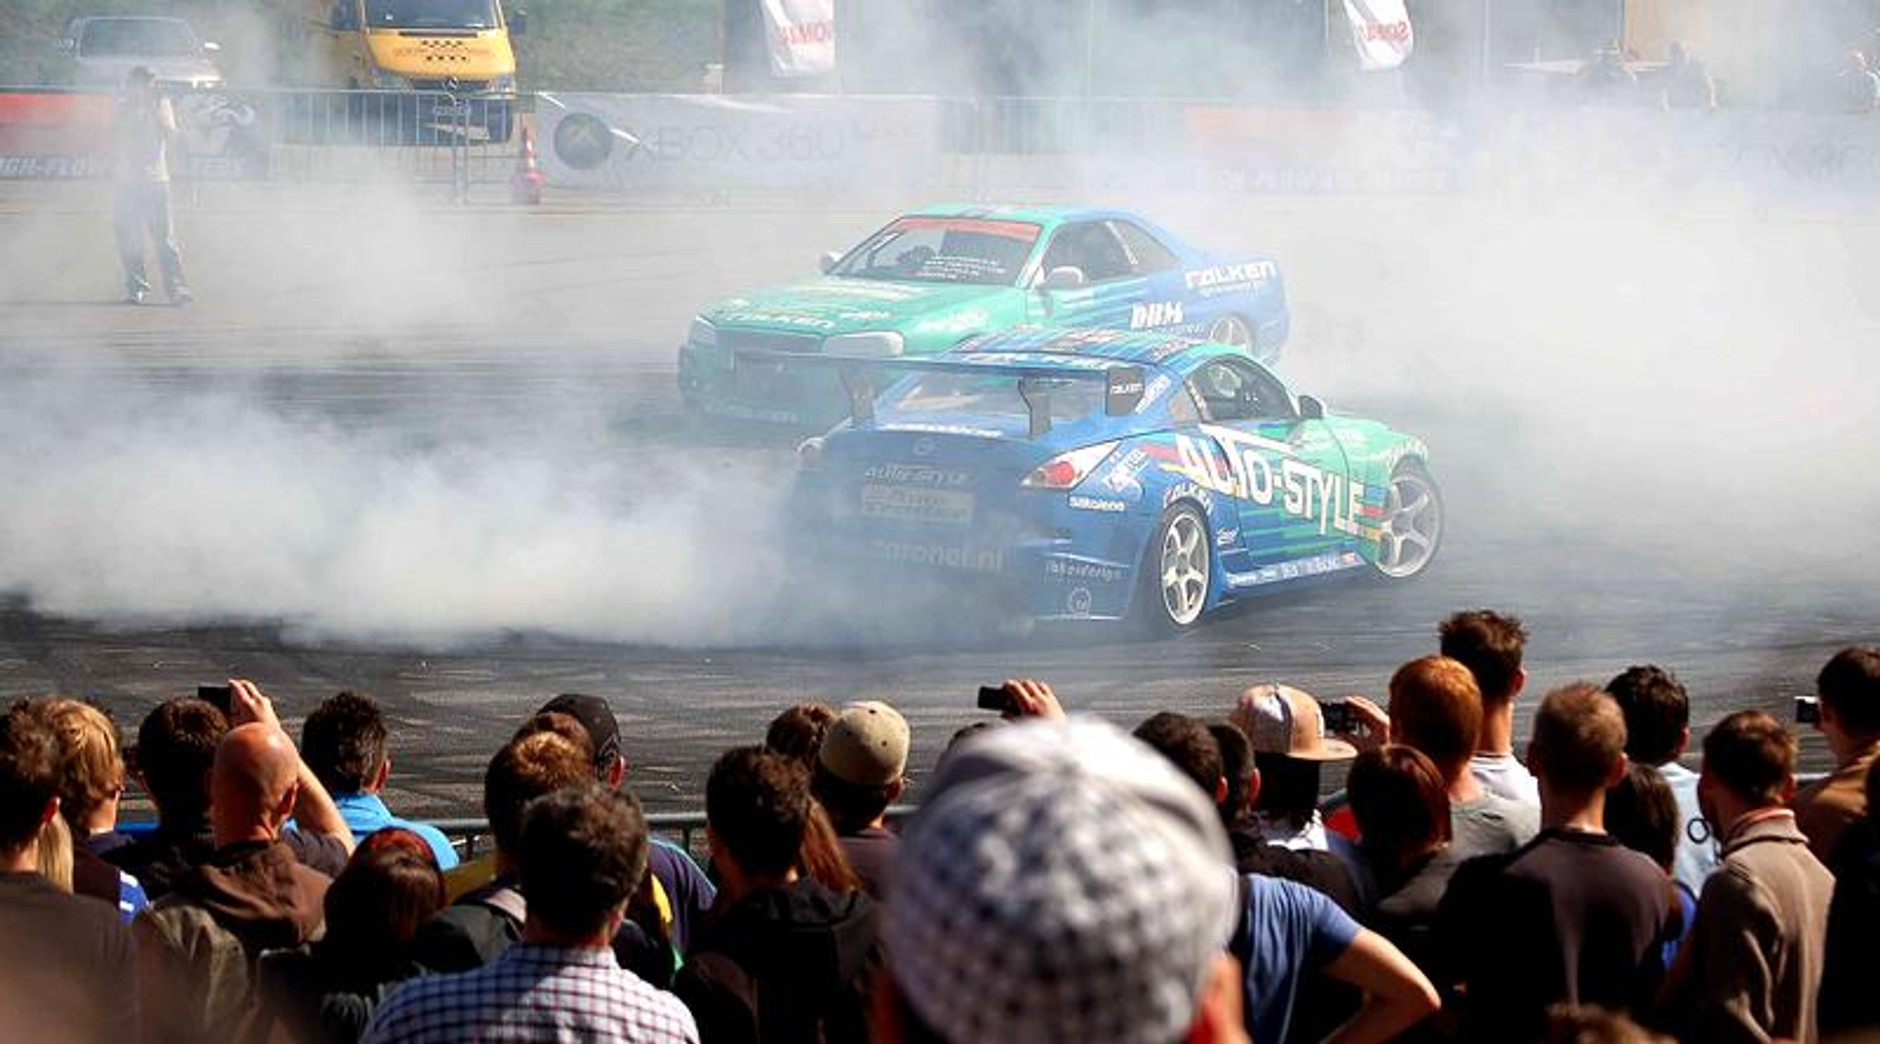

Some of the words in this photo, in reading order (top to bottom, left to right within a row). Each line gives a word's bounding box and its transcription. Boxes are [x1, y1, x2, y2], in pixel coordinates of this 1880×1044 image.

[622, 125, 749, 162] XBOX
[1183, 261, 1277, 290] FALKEN
[1174, 424, 1365, 538] AUTO-STYLE
